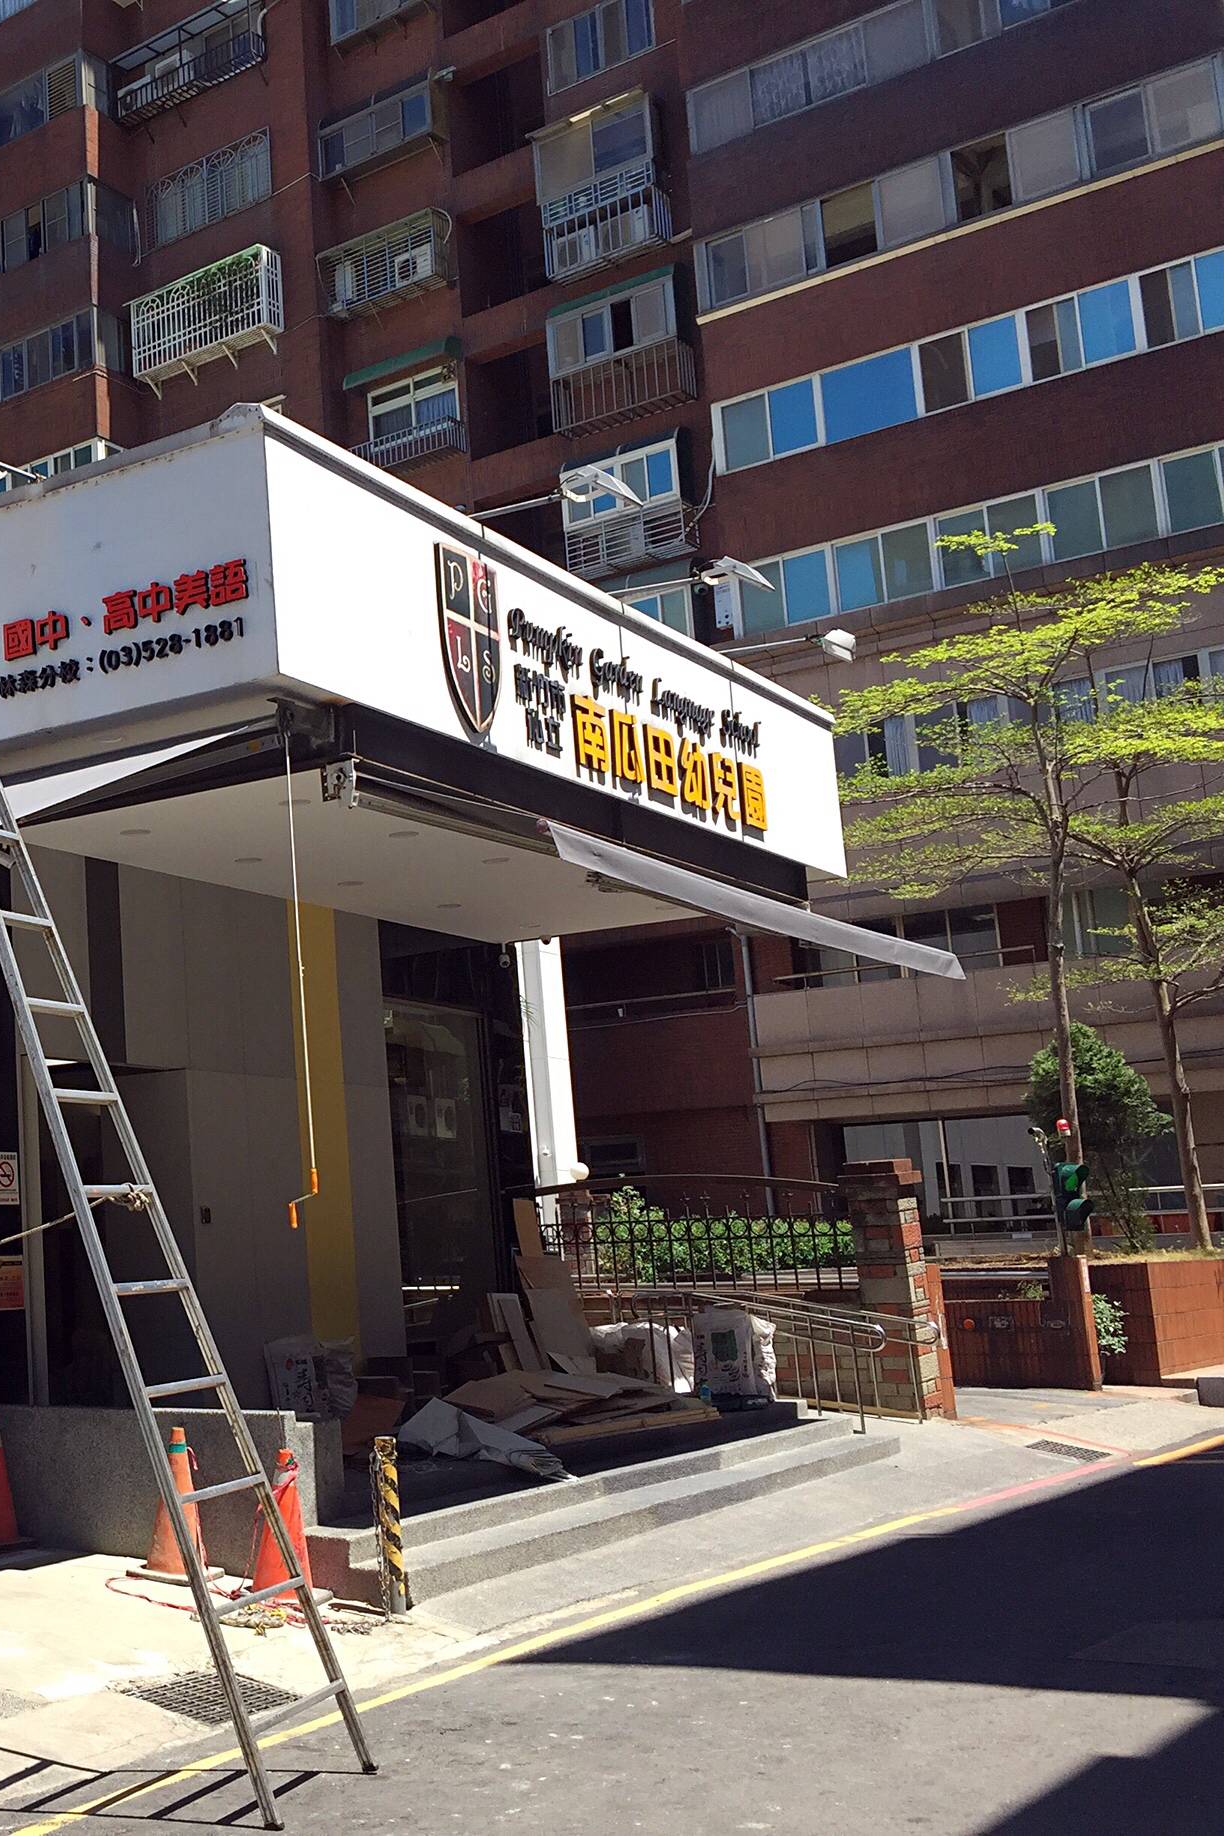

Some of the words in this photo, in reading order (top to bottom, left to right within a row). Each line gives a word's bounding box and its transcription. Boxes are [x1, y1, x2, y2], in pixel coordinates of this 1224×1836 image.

[571, 694, 769, 832] 南瓜田幼兒園
